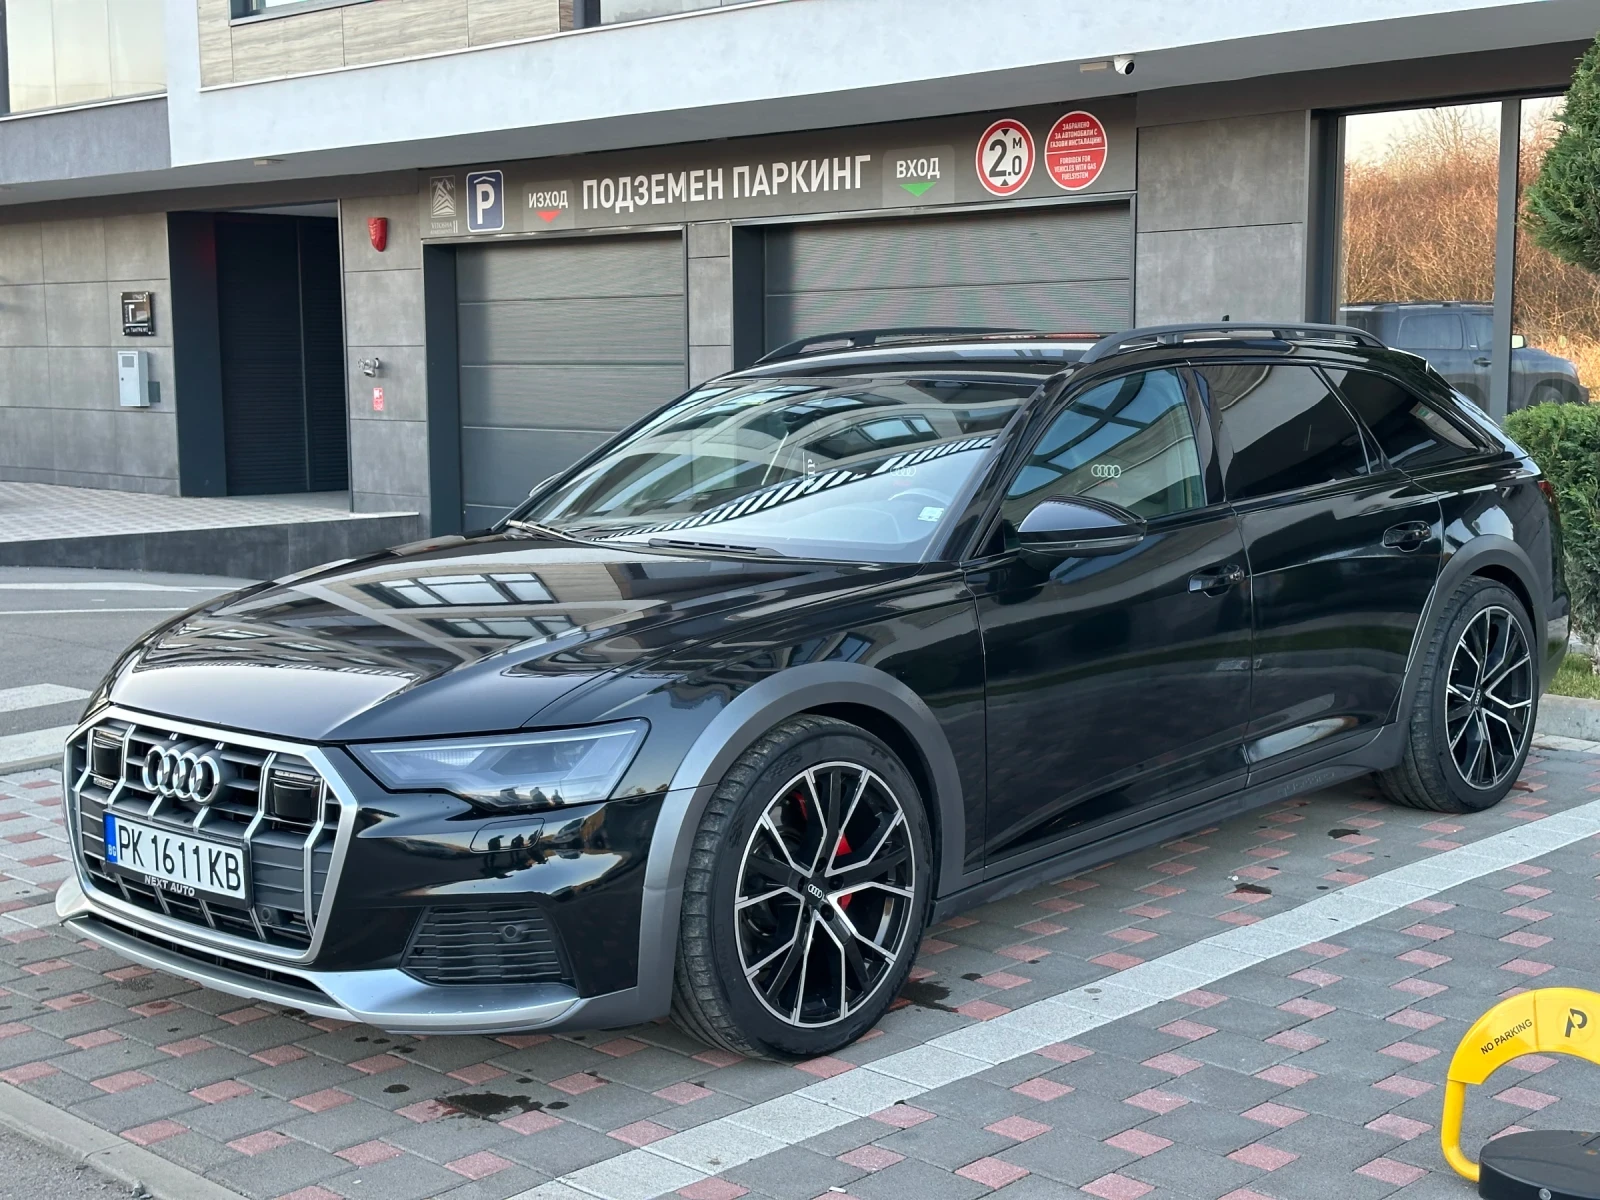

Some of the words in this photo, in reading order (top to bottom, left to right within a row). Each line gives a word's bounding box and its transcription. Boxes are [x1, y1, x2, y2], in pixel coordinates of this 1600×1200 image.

[896, 157, 940, 180] ВХОД
[1075, 163, 1087, 171] WITH
[1087, 162, 1096, 170] GAS
[582, 168, 723, 213] ПОДЗЕМЕН
[732, 154, 871, 199] ПАРКИНГ
[476, 183, 495, 225] P
[528, 190, 568, 209] ИЗХОД
[108, 844, 117, 857] BG
[118, 825, 145, 868] PK
[151, 834, 201, 883] 1611
[208, 847, 241, 892] KB
[144, 875, 169, 890] NEXT
[170, 883, 195, 897] AUTO
[1480, 1042, 1494, 1055] NO
[1494, 1018, 1533, 1047] PARKING
